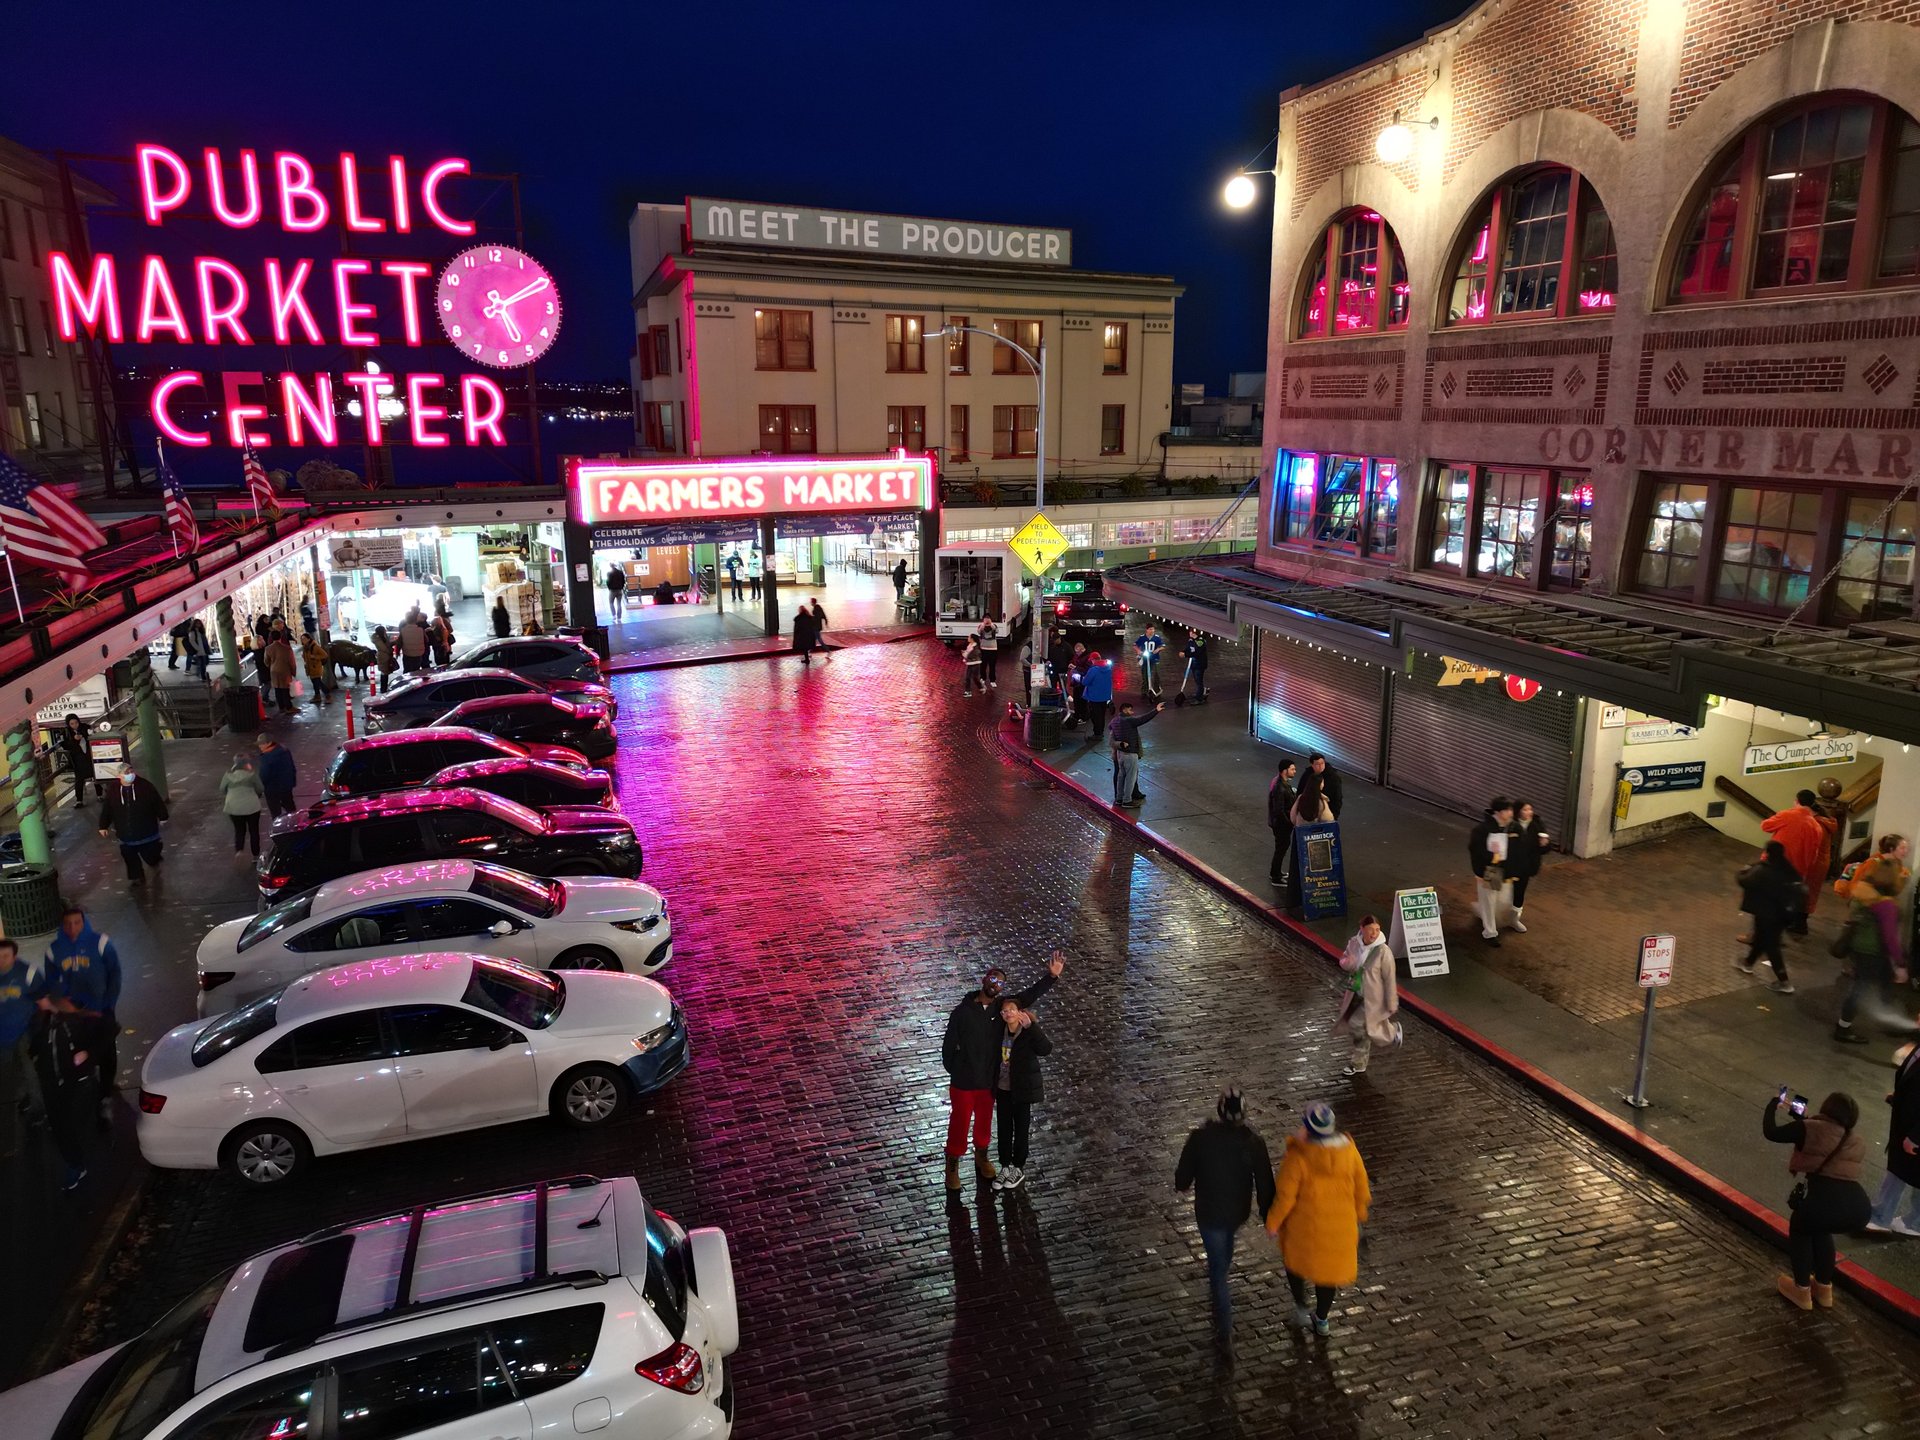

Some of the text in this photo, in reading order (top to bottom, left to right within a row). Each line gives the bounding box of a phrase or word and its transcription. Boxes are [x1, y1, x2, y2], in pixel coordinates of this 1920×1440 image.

[136, 143, 476, 236] PUBLIC
[707, 205, 1062, 261] MEET THE PRODUCER
[464, 256, 475, 268] 11
[488, 249, 502, 262] 12
[519, 257, 524, 270] 1
[447, 273, 460, 286] 10
[48, 251, 432, 346] MARKET
[442, 299, 453, 312] 9
[545, 301, 555, 314] 3
[452, 325, 462, 338] 8
[539, 326, 549, 339] 4
[473, 344, 482, 355] 7
[525, 344, 534, 357] 5
[498, 350, 509, 363] 6
[151, 370, 507, 447] CENTER
[1538, 426, 1914, 479] CORNER MAR
[598, 470, 916, 513] FARMERS MARKET
[867, 515, 876, 523] AT
[876, 514, 892, 523] PIKE
[892, 514, 914, 522] PLACE
[594, 528, 643, 537] CELEBRATE
[887, 522, 915, 531] MARKET
[595, 537, 656, 548] THE HOLIDAYS
[656, 545, 681, 556] LEVELS
[1143, 641, 1156, 653] 10
[38, 712, 63, 720] YEARS
[1751, 748, 1772, 764] The
[1774, 744, 1820, 762] Crumpet
[1824, 739, 1854, 757] Shop
[1647, 765, 1703, 777] WILD FISH POKE
[1403, 895, 1435, 907] Pike Place
[1404, 910, 1415, 920] Bar
[1416, 909, 1423, 918] &
[1645, 939, 1656, 947] NO
[1647, 948, 1670, 958] STOPS
